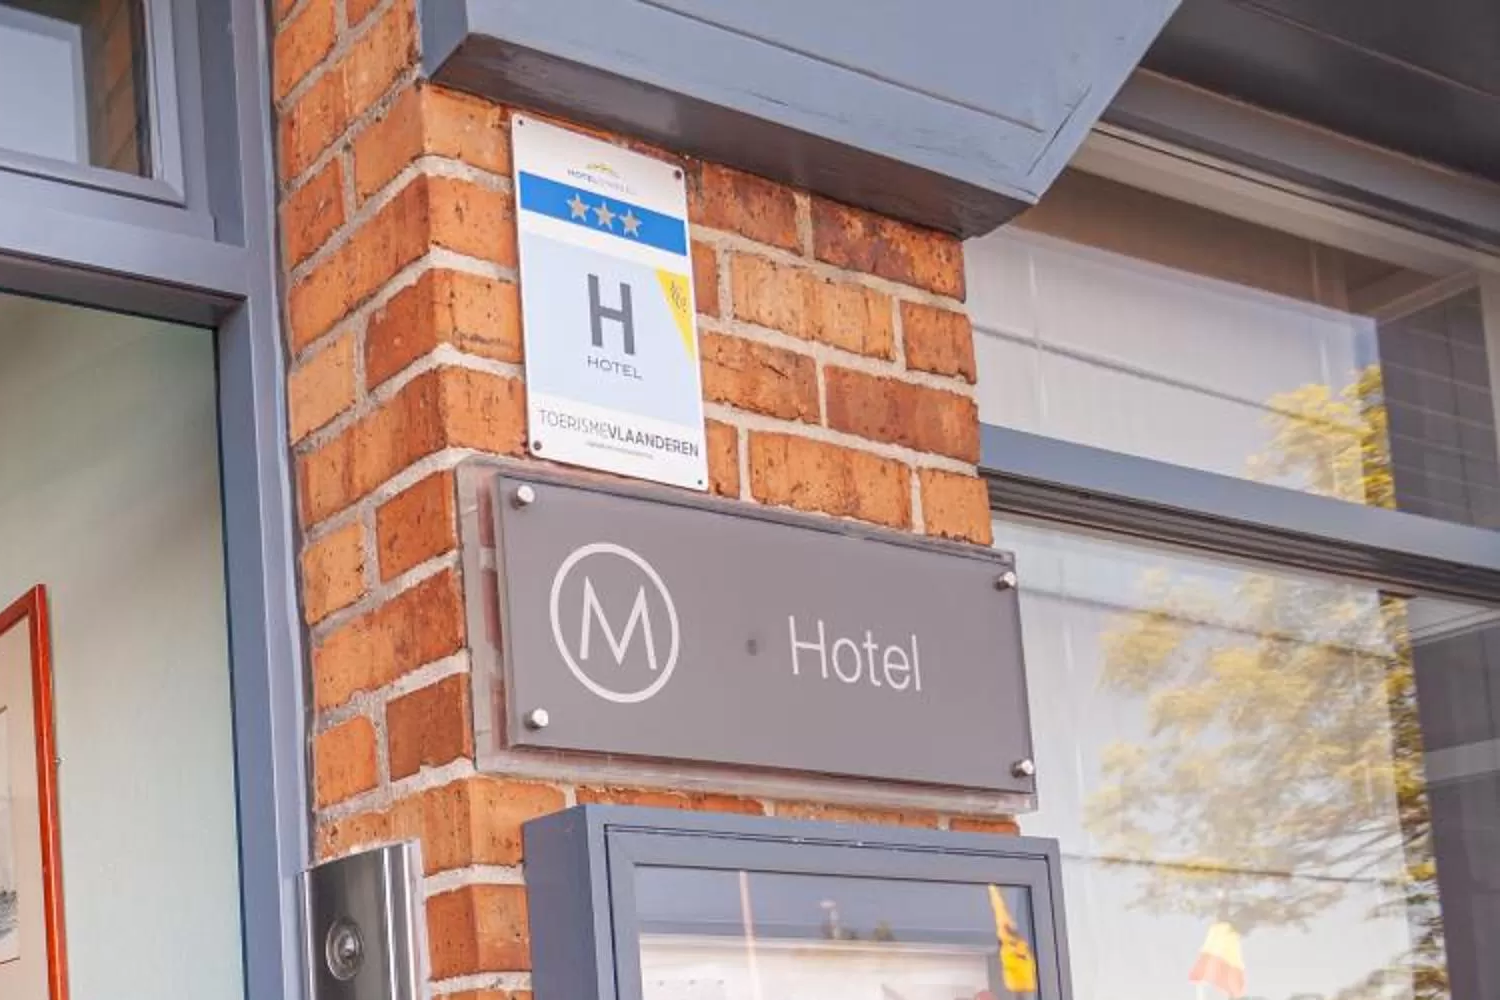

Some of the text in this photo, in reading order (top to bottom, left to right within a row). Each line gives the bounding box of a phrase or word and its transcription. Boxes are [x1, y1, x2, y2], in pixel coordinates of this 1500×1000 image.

[587, 273, 636, 356] H
[587, 355, 643, 380] HOTEL
[580, 575, 922, 692] M Hotel
